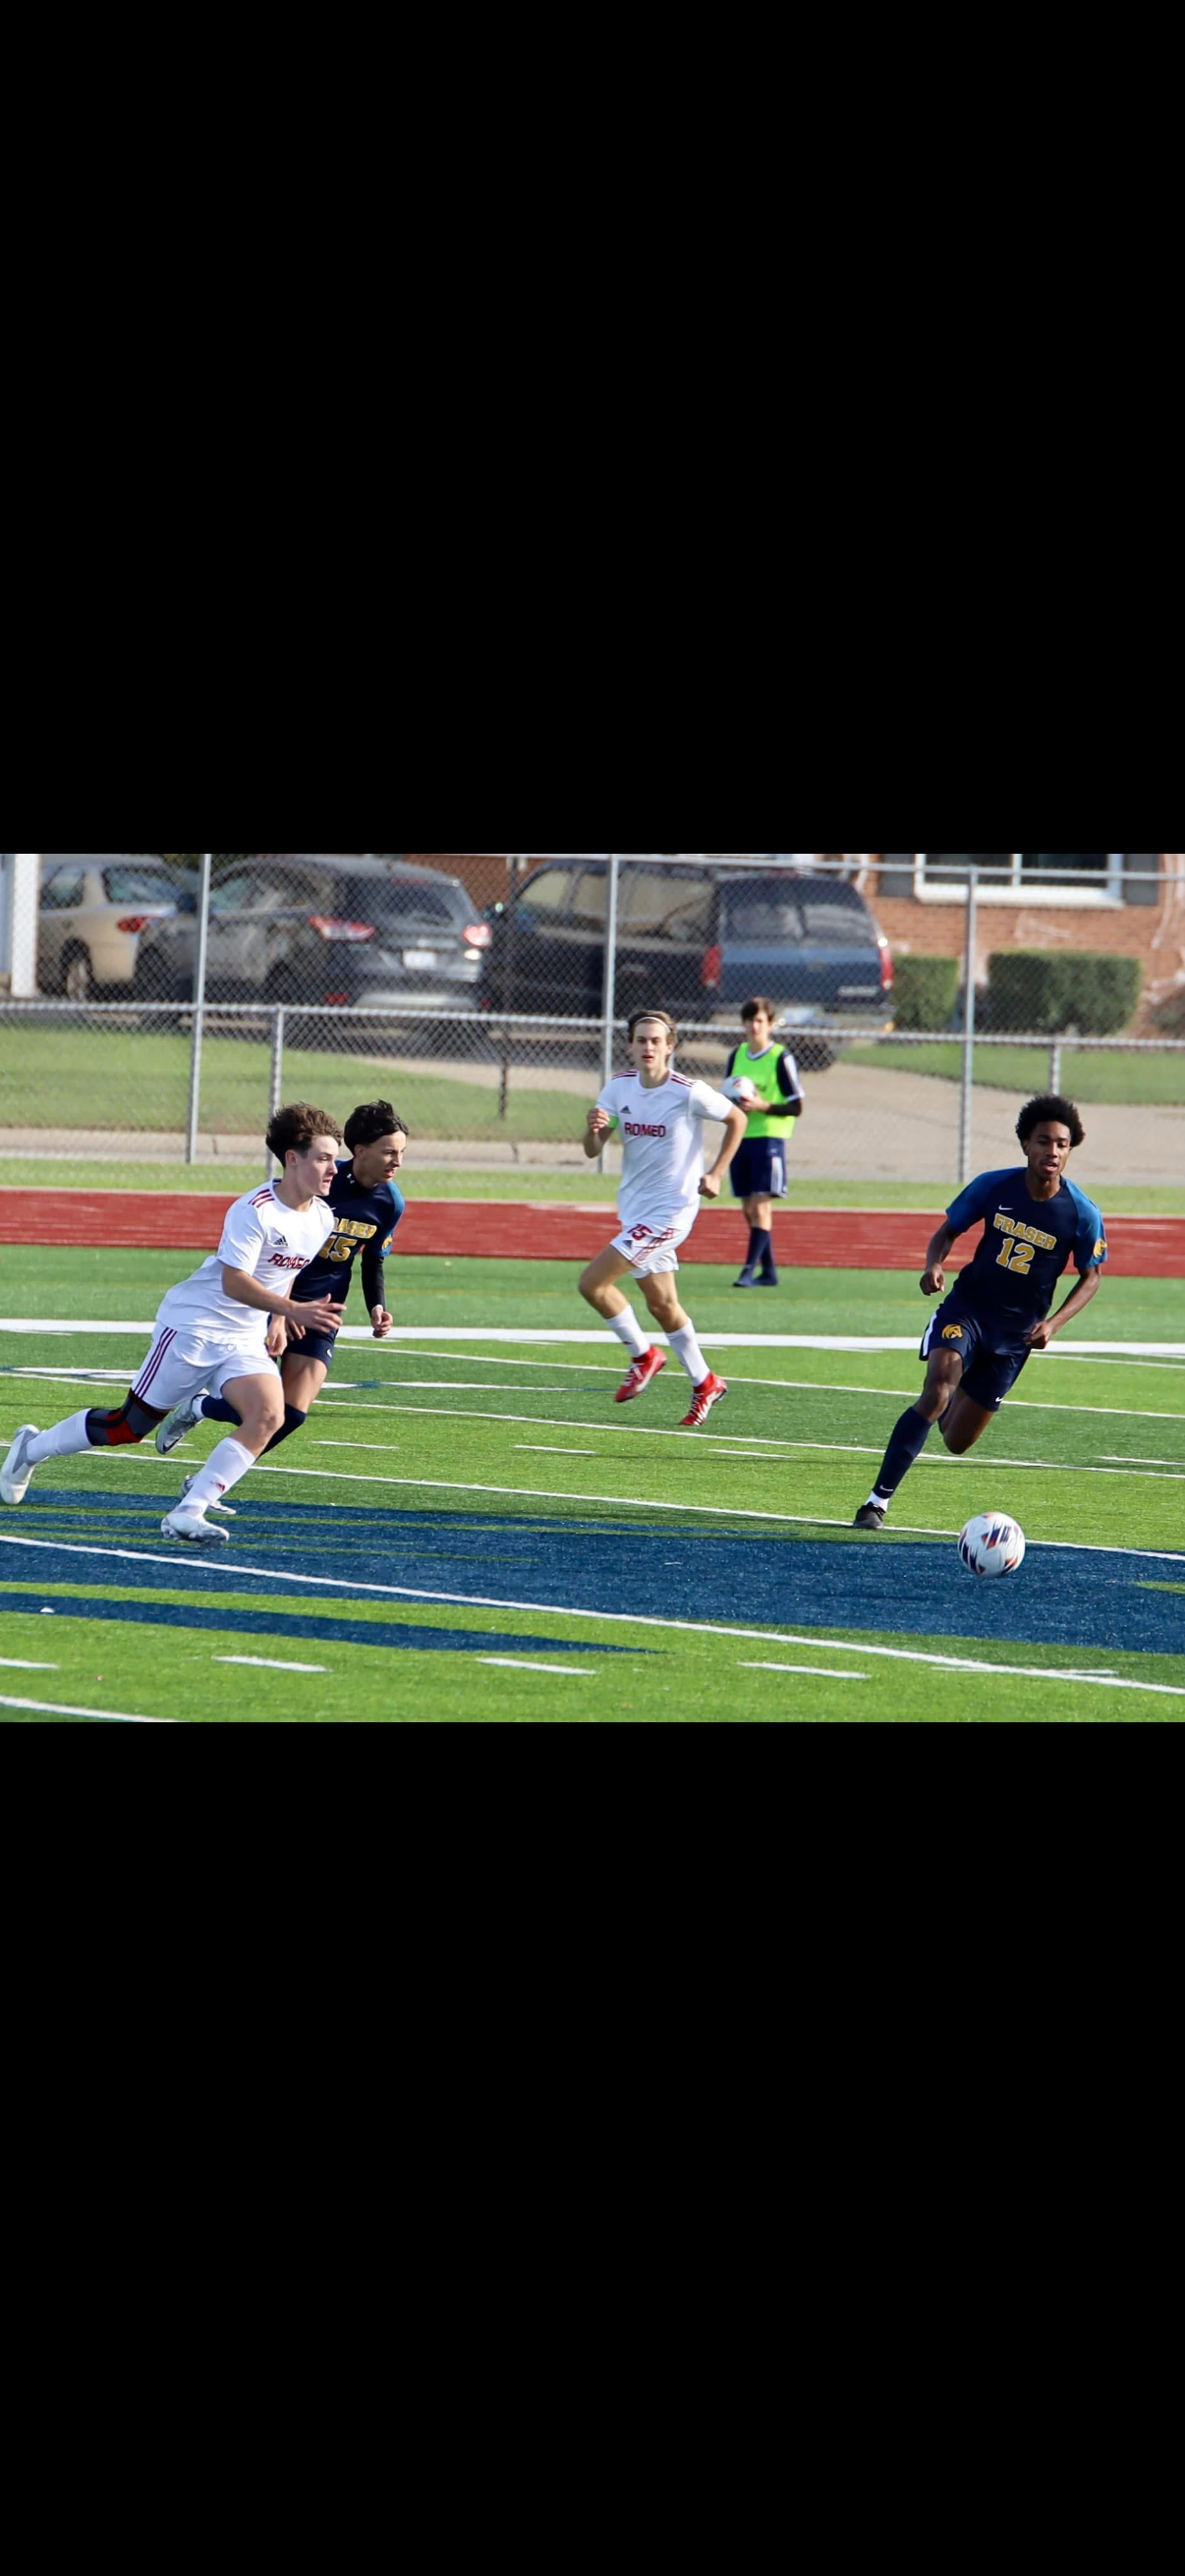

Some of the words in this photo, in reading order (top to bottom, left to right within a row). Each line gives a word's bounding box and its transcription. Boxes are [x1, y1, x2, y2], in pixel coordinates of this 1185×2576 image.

[624, 1121, 666, 1138] ROMEO
[333, 1216, 377, 1239] ASER
[993, 1212, 1057, 1251] FRASER
[995, 1237, 1035, 1274] 12
